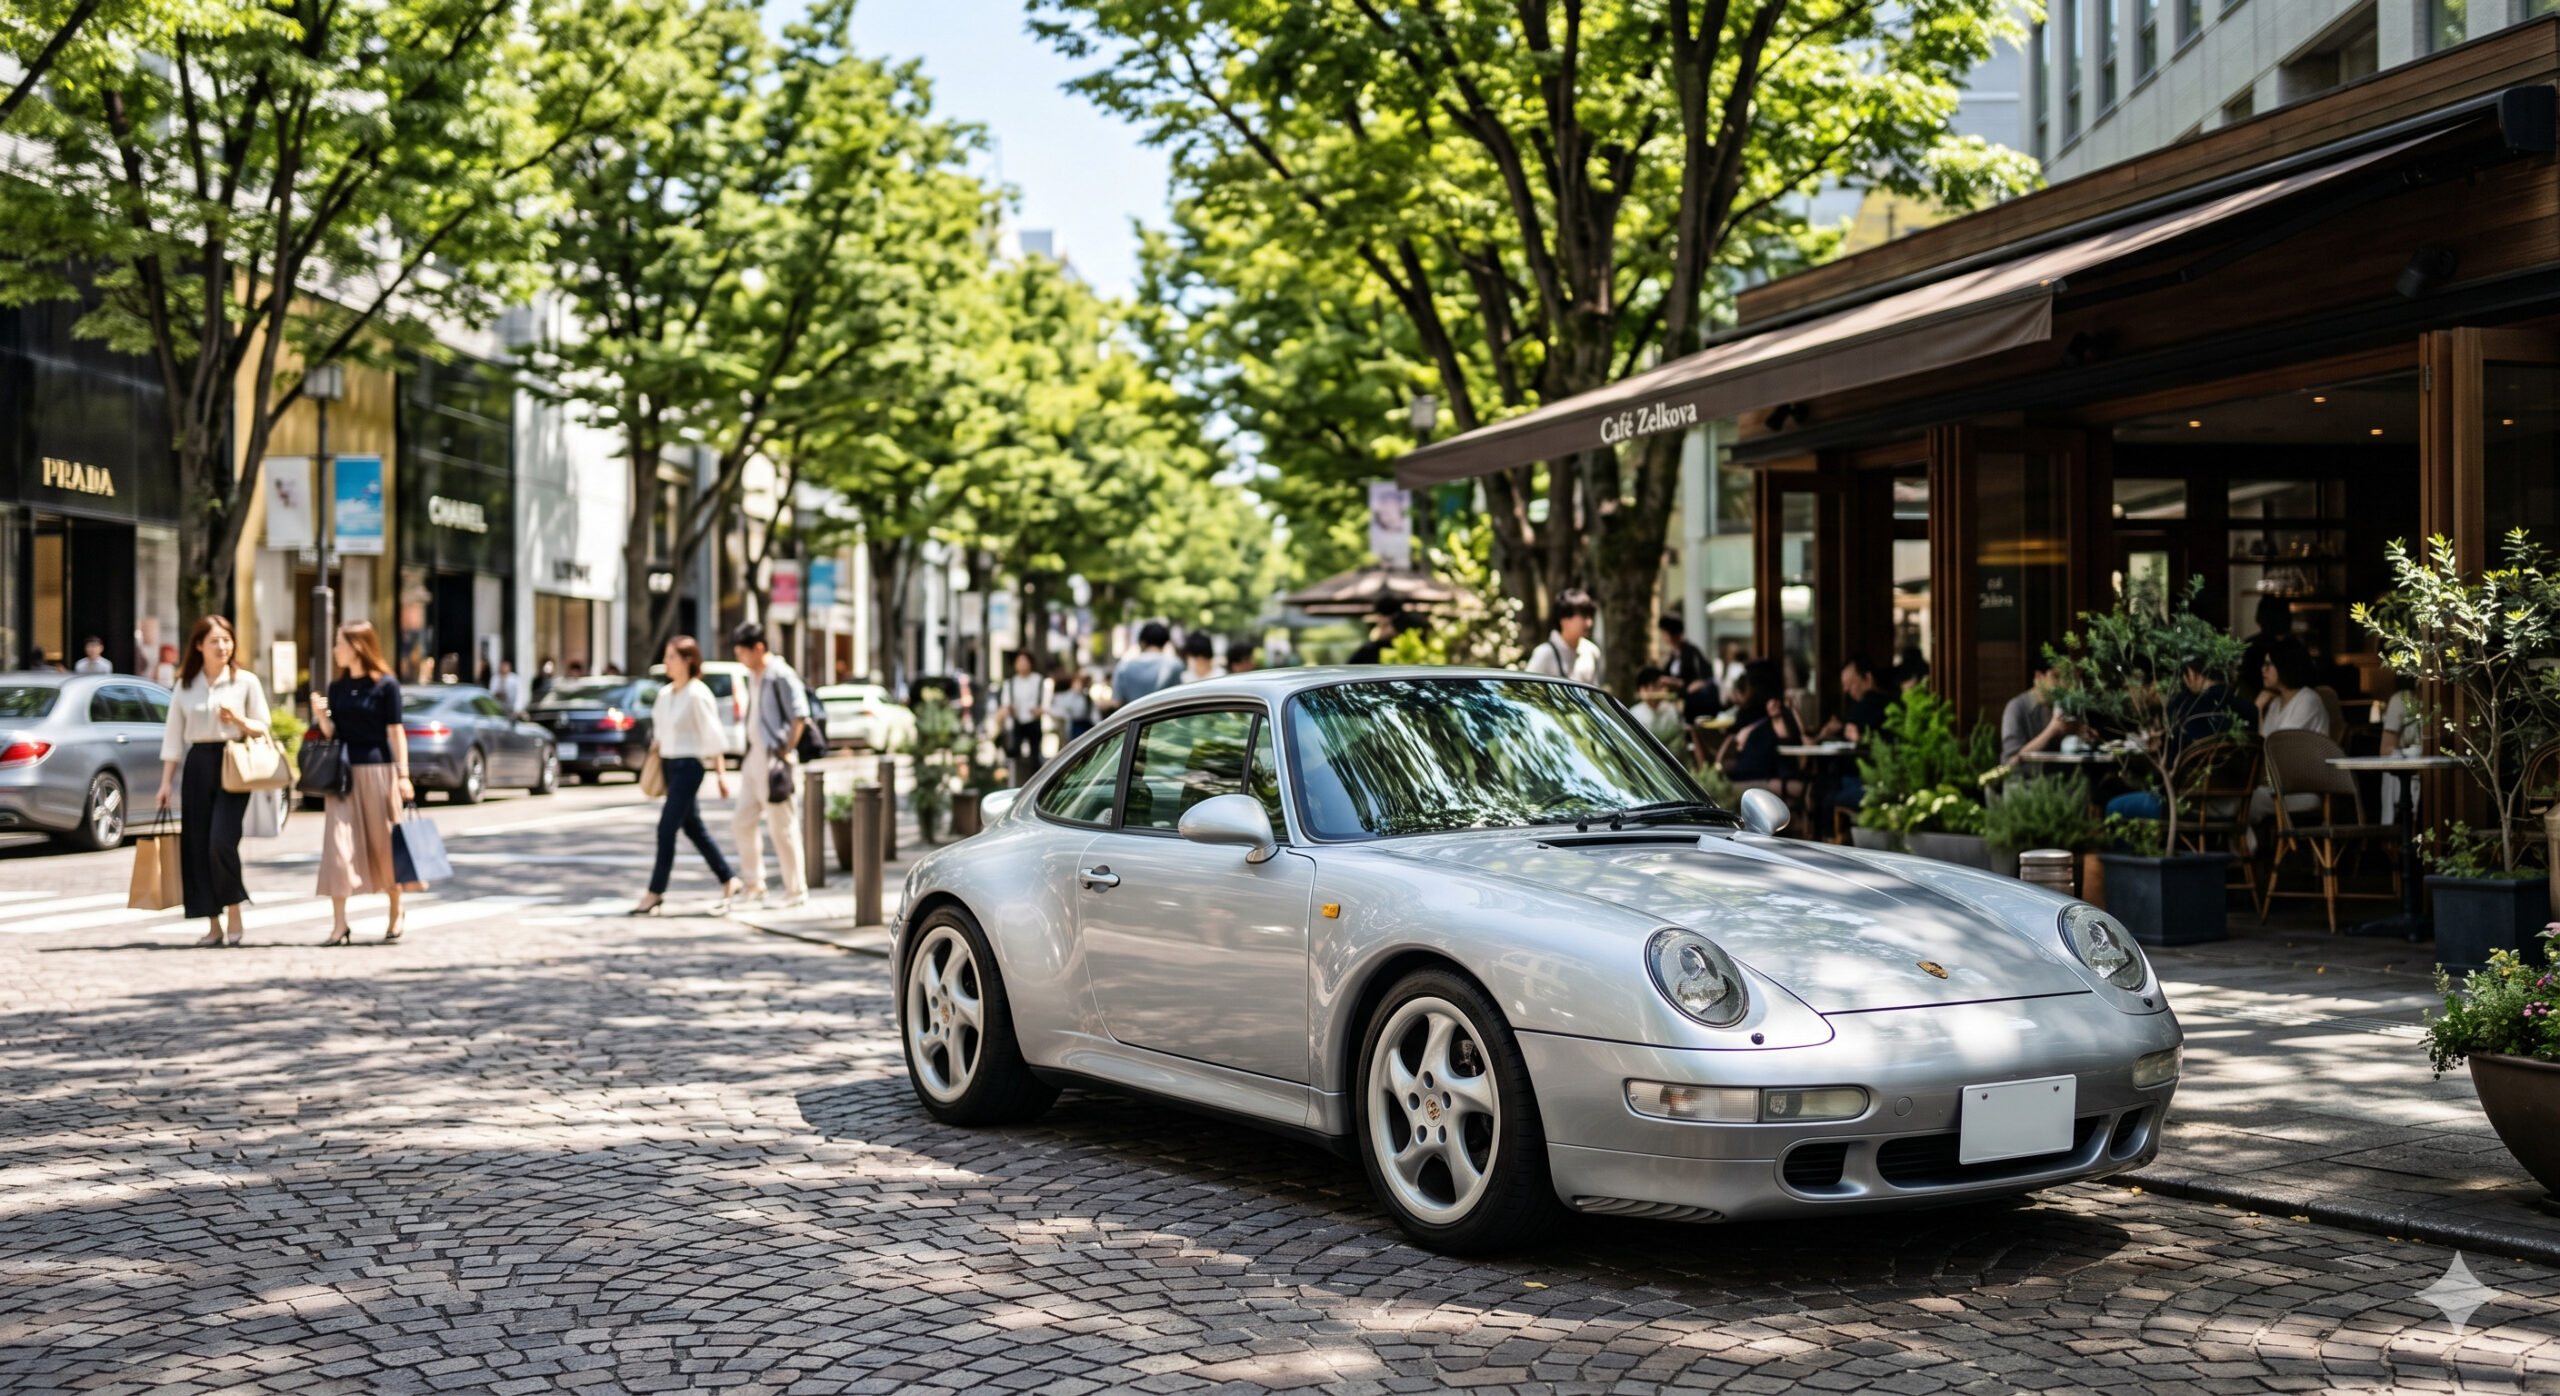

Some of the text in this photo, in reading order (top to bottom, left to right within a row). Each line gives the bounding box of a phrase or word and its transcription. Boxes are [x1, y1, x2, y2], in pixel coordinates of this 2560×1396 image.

[1600, 402, 1698, 444] Café Zelkova
[42, 456, 115, 497] PRADA
